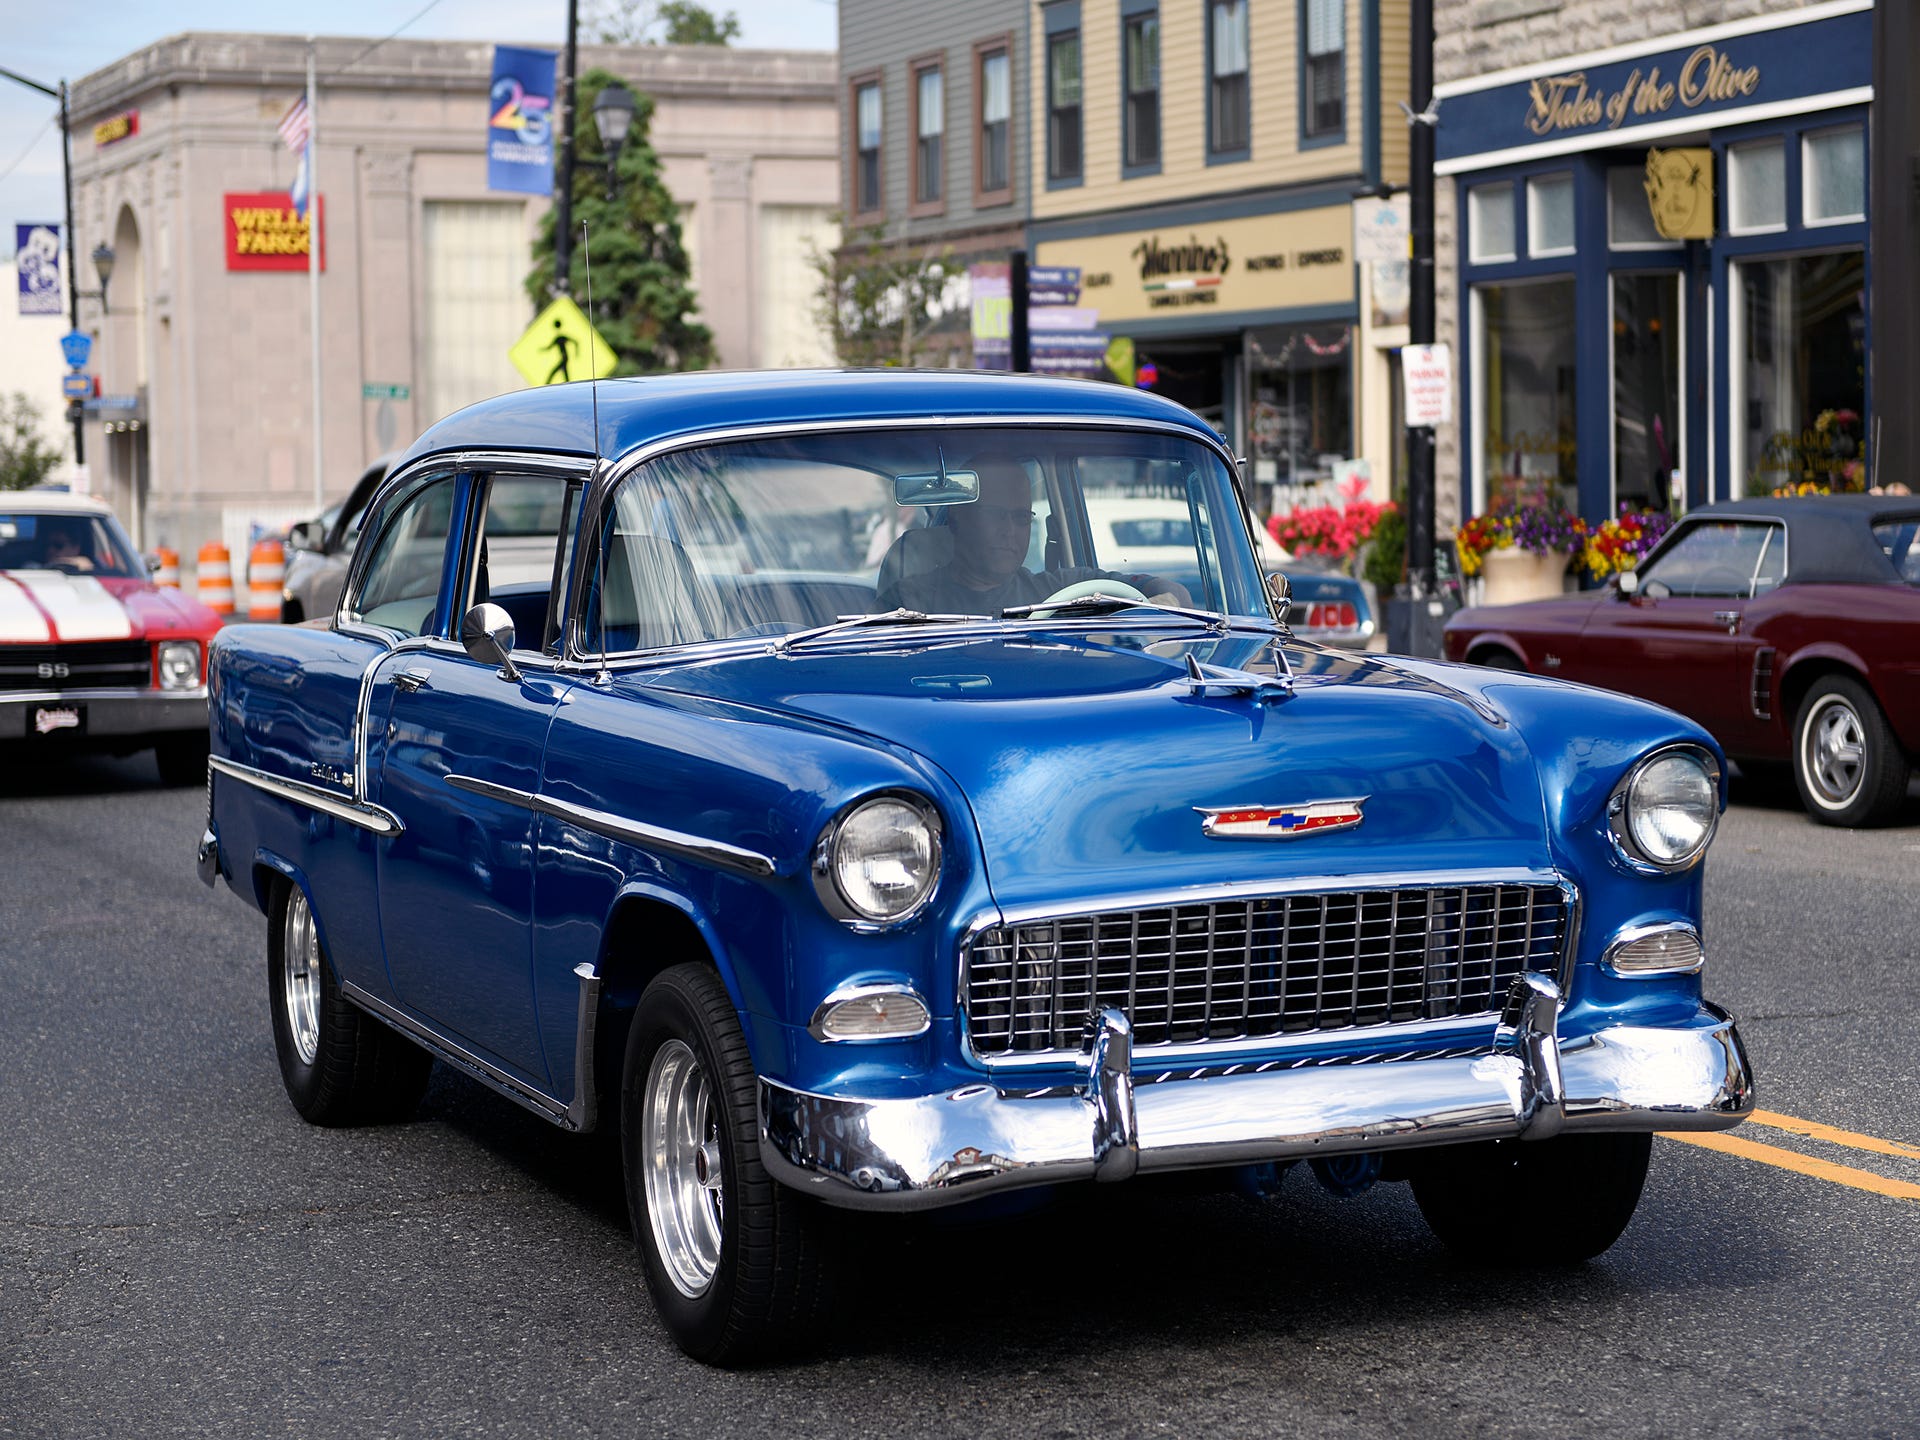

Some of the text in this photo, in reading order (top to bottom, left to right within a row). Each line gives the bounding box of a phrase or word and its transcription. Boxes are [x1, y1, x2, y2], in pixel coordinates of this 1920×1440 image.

[1525, 44, 1761, 136] Tales of the Olive
[37, 662, 70, 678] SS
